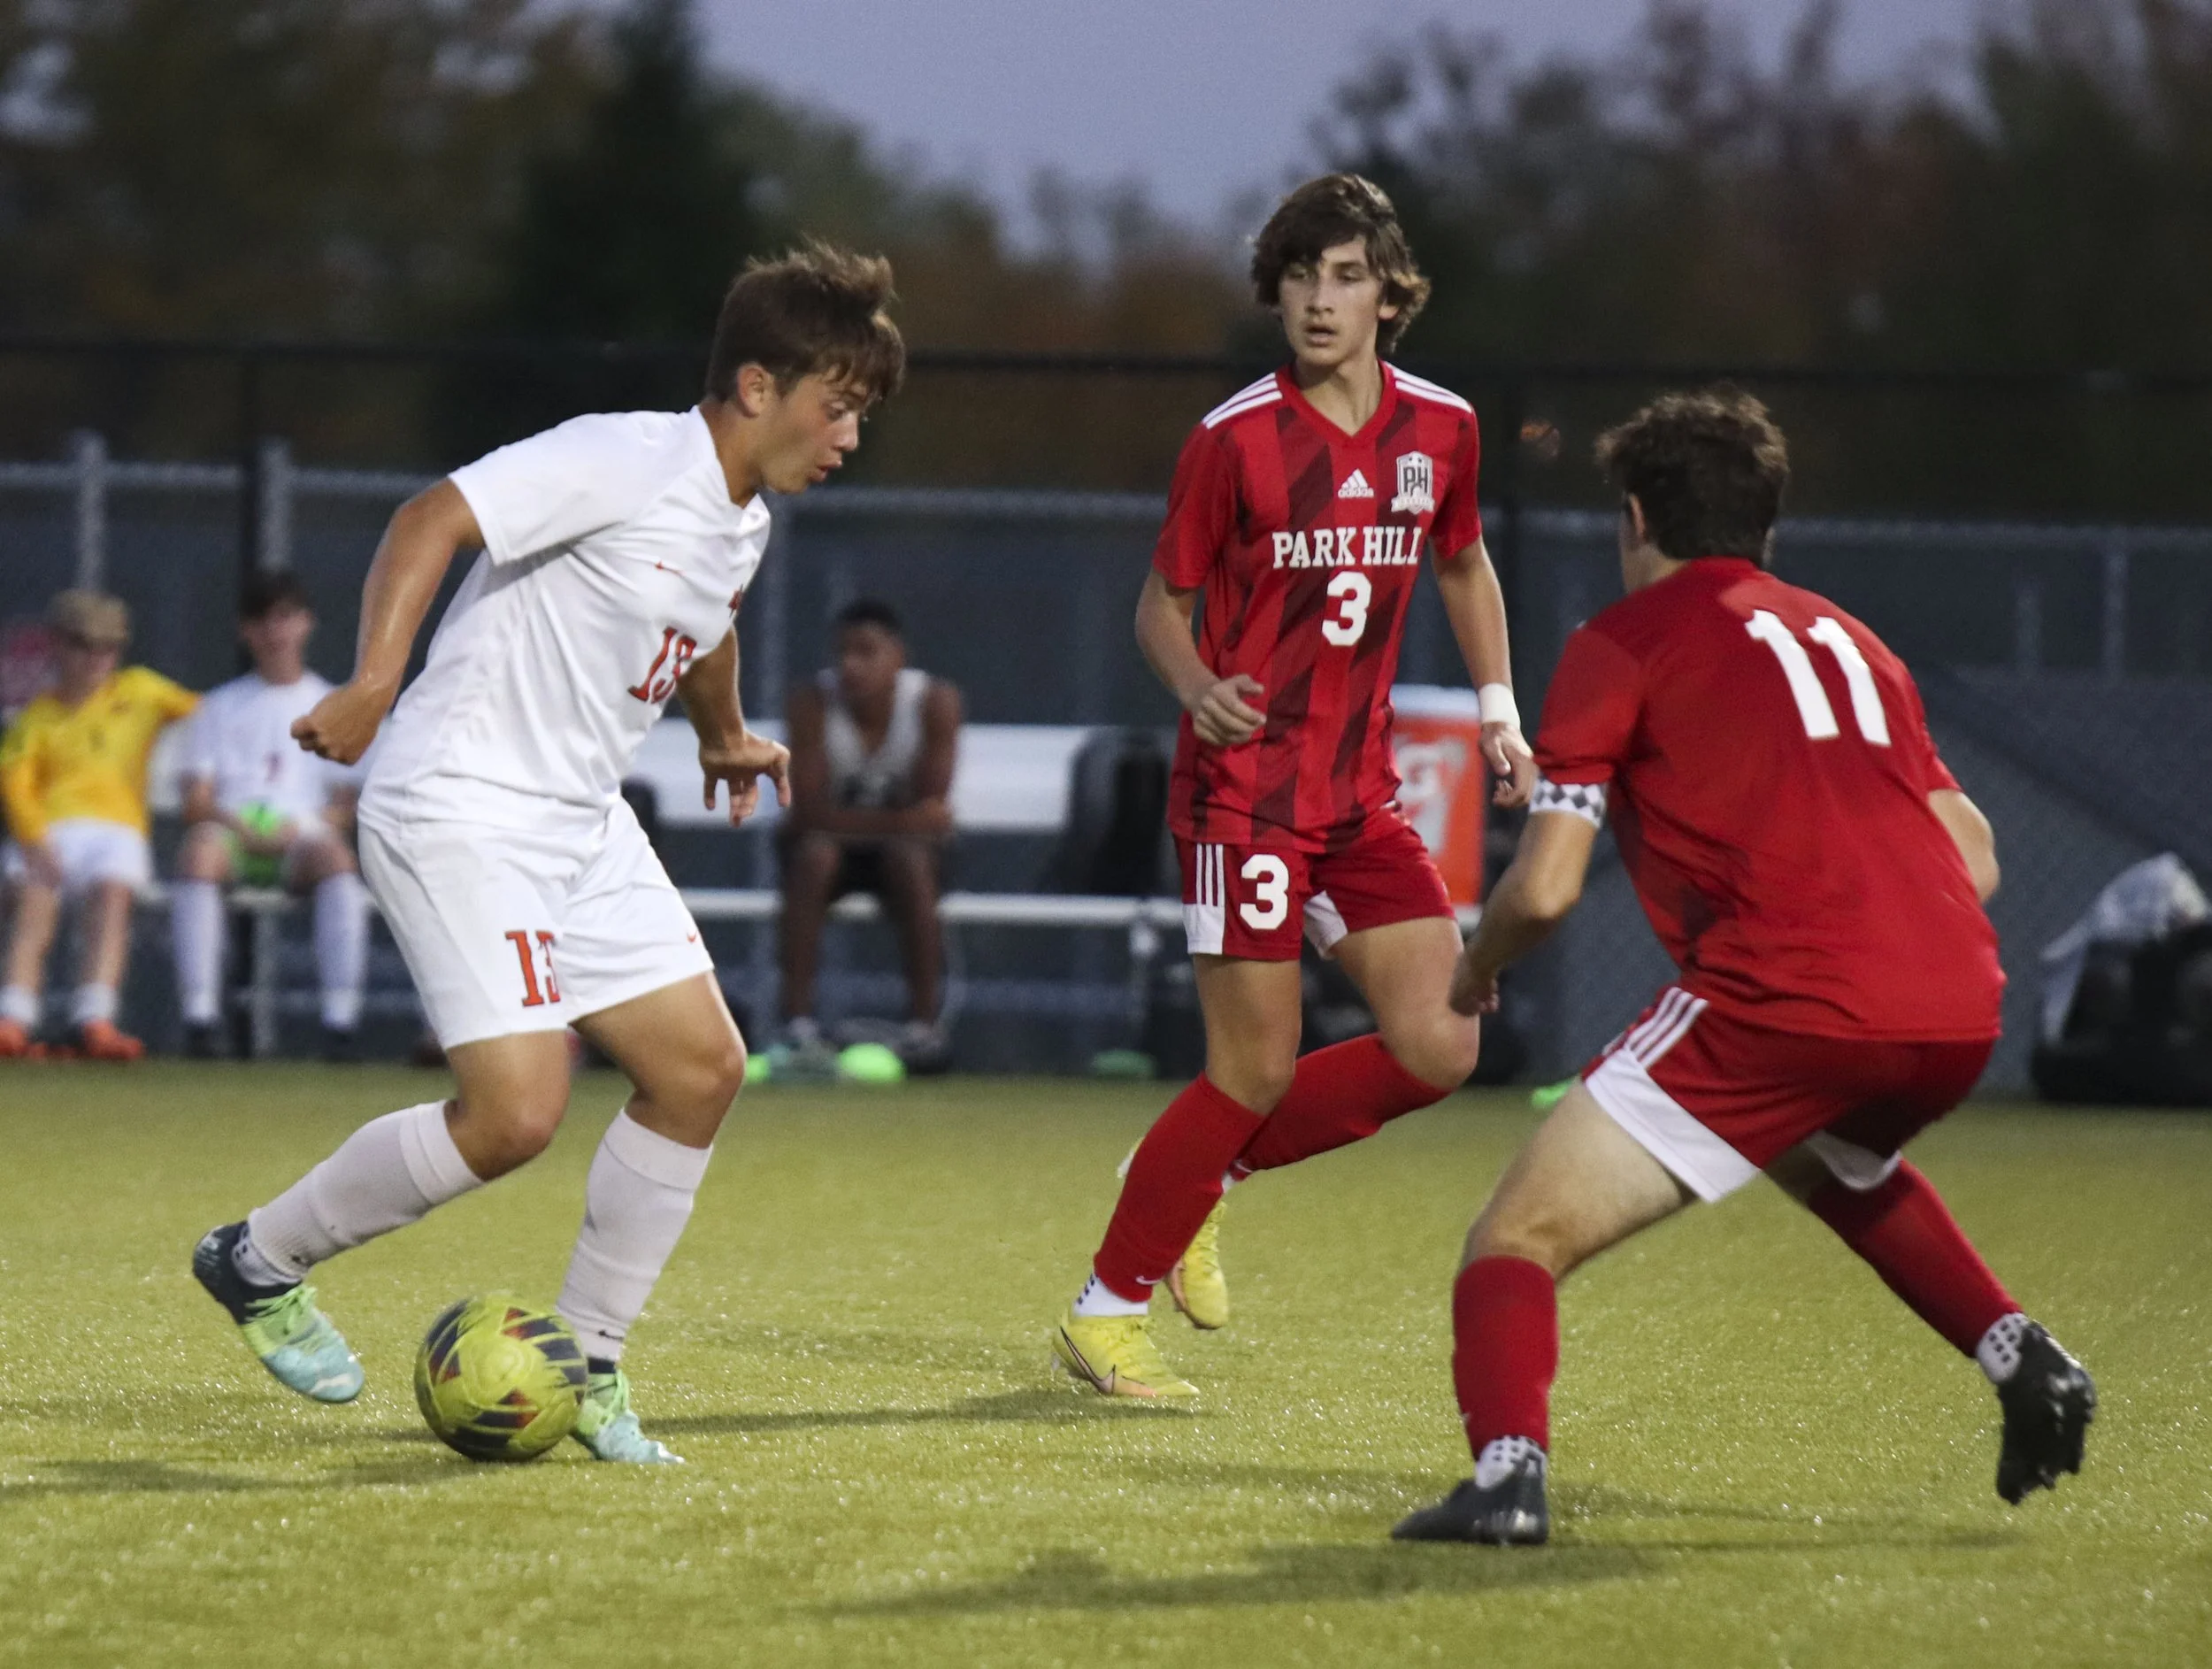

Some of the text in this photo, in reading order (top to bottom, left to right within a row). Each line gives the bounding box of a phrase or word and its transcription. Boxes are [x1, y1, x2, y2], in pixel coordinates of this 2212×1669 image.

[1271, 527, 1356, 569] PARK
[1321, 571, 1371, 646] 3
[1745, 609, 1892, 747] 11
[1240, 854, 1289, 930] 3
